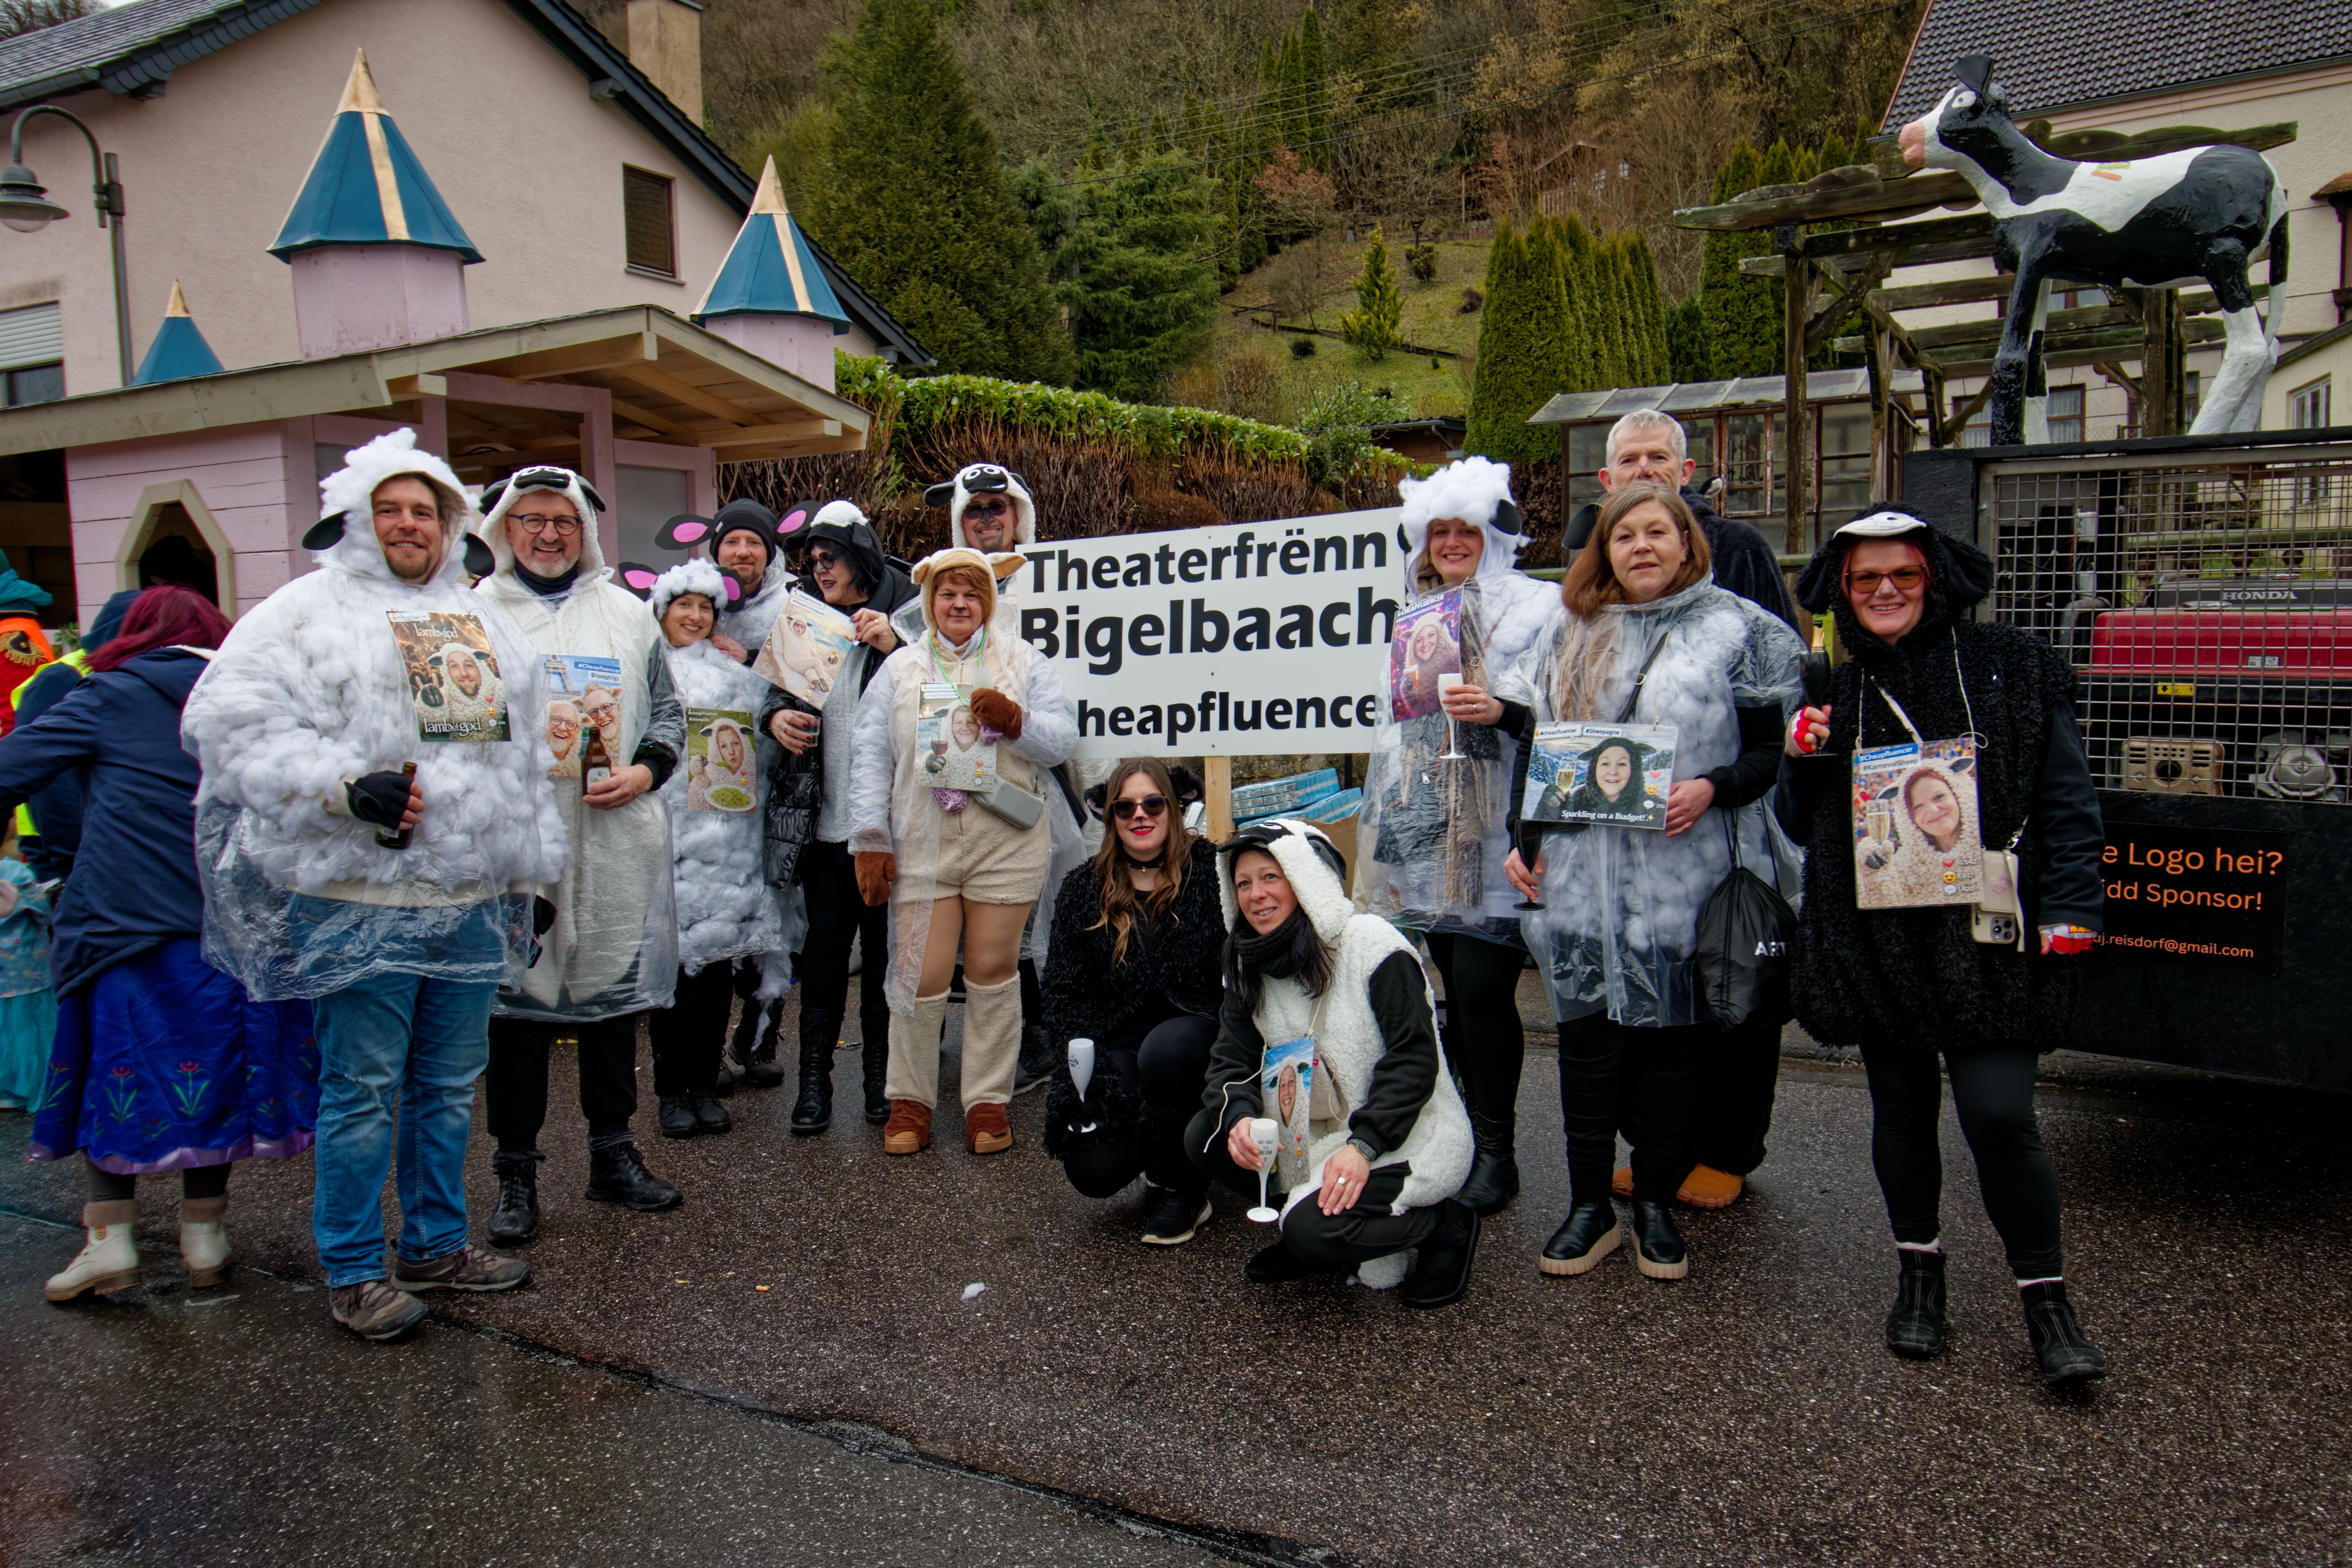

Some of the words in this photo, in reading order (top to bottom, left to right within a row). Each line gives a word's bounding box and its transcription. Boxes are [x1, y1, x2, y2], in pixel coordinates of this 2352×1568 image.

[1023, 527, 1387, 593] Theaterfrënn
[2223, 591, 2298, 600] HONDA
[1021, 586, 1400, 675] Bigelbaach
[578, 663, 621, 673] #Cheapfluencer
[591, 672, 619, 682] Sheeptrip
[1078, 691, 1378, 746] heapfluence
[423, 717, 453, 734] lamb
[459, 716, 483, 737] god
[1540, 728, 1577, 736] #cheapfluencer
[1859, 747, 1914, 761] #Cheapfluencer
[1863, 758, 1919, 771] #KarnevalSheep
[1561, 810, 1596, 820] Sparkling
[1614, 812, 1645, 822] Budget!
[2129, 842, 2204, 874] Logo
[2216, 847, 2283, 875] hei?
[2146, 883, 2262, 910] Sponsor!
